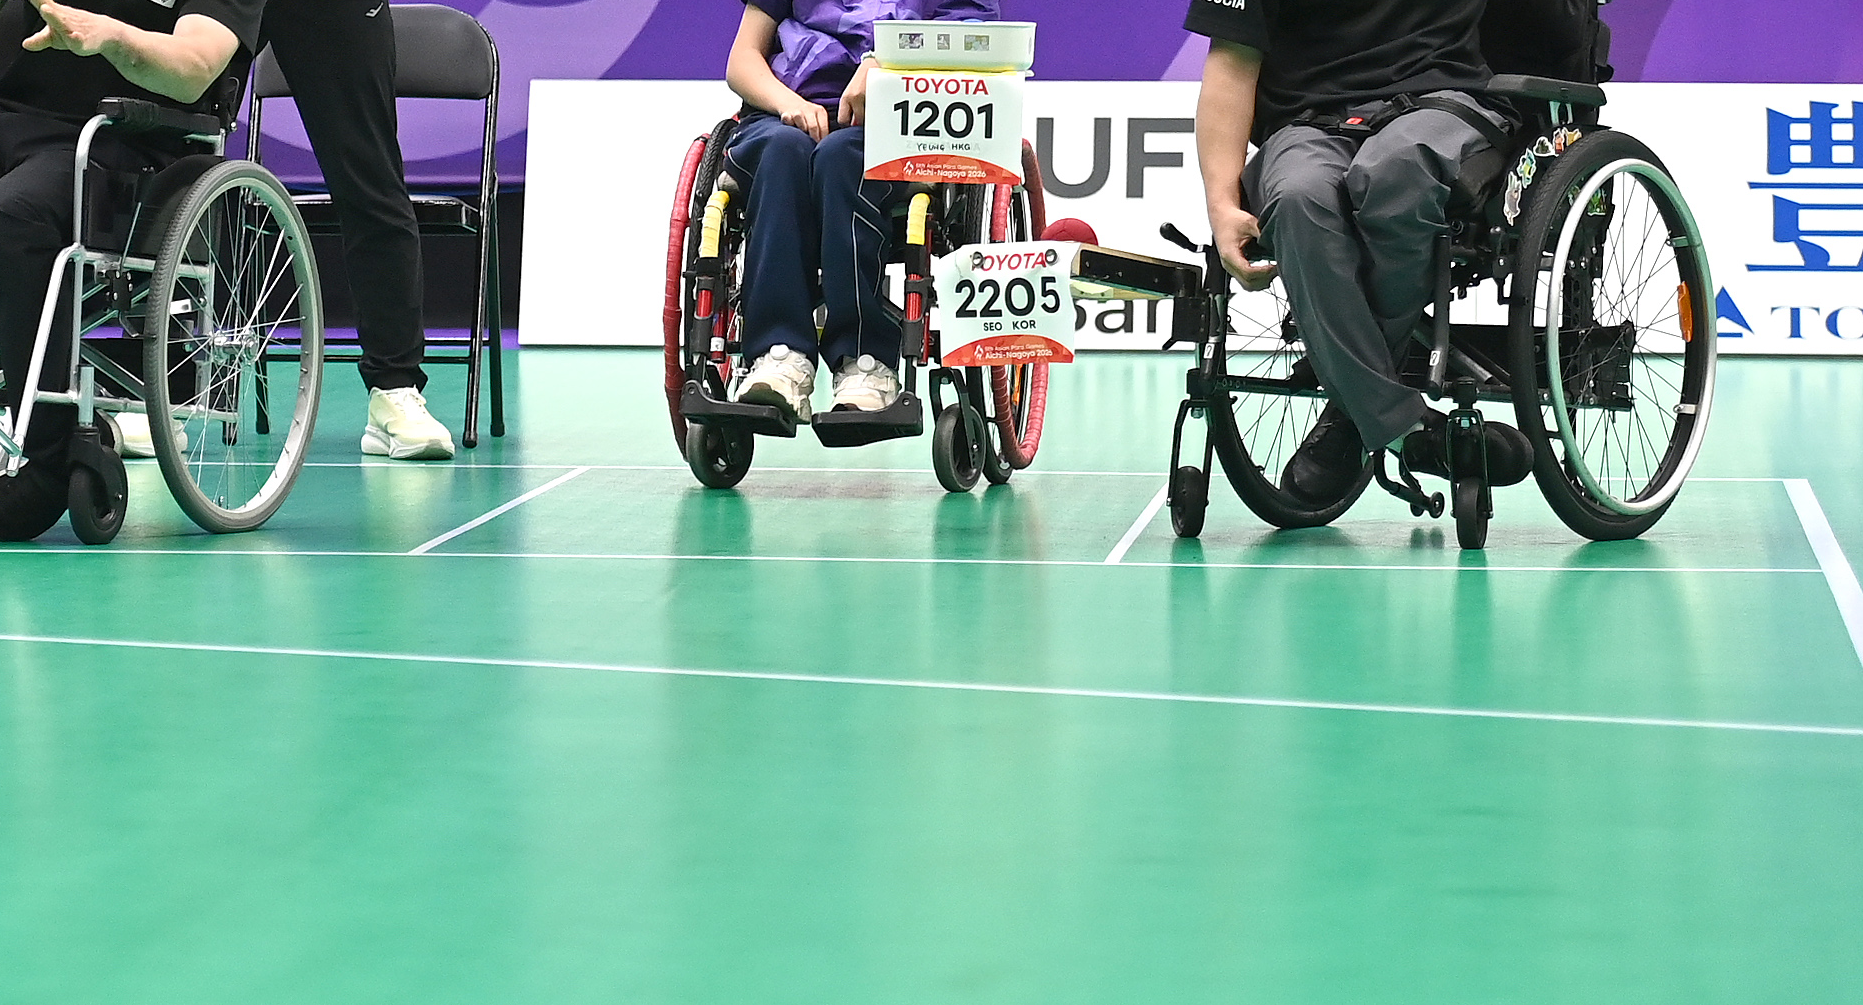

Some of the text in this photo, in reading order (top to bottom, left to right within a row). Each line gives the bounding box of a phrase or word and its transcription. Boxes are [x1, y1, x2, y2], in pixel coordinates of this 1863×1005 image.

[901, 76, 989, 95] TOYOTA
[893, 100, 994, 139] 1201
[951, 143, 971, 151] HKG
[915, 168, 987, 178] Aichi-Nagoya 2026
[955, 276, 1060, 318] 2205
[983, 320, 1037, 332] SEO KOR
[985, 349, 1053, 359] Aichi-Nagoya 2026
